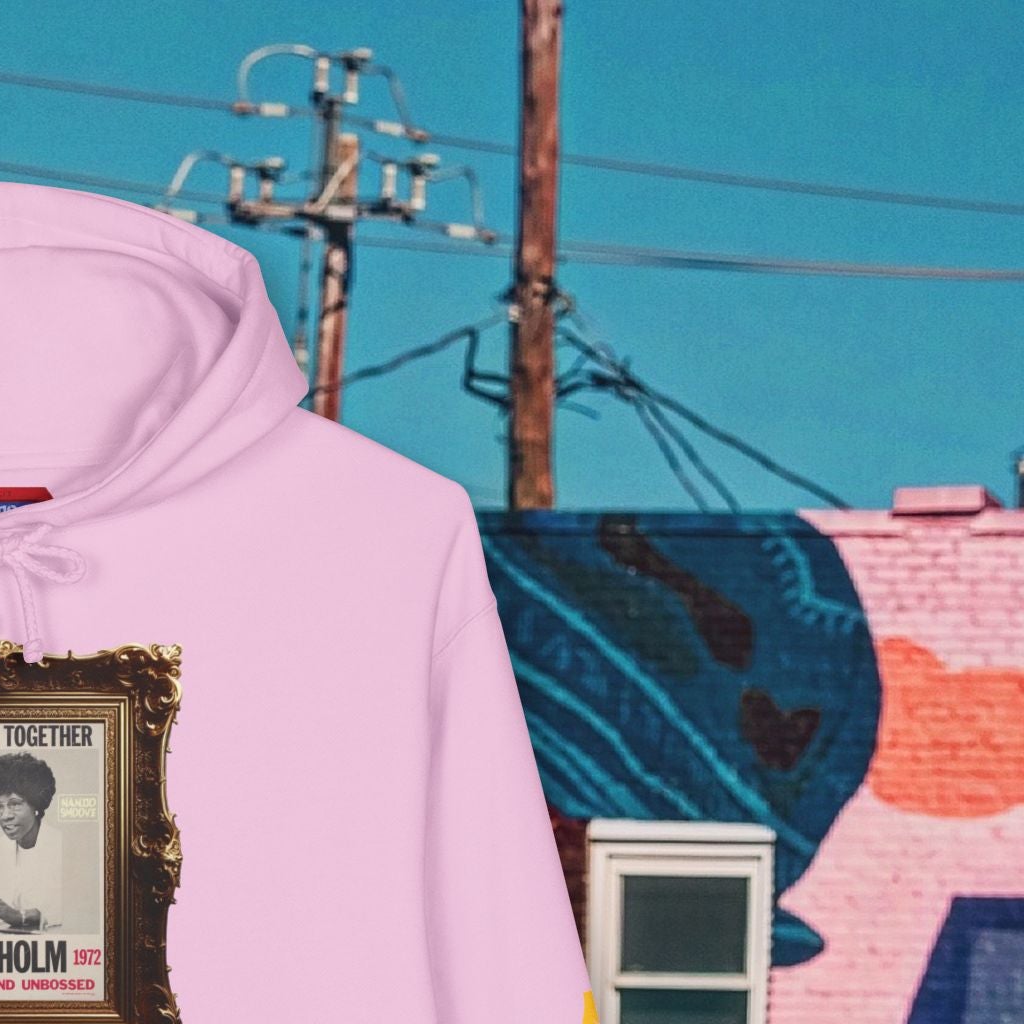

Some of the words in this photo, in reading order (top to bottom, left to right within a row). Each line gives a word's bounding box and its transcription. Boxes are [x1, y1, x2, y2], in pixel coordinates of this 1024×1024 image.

[4, 725, 93, 747] TOGETHER
[73, 948, 102, 966] 1972
[22, 979, 95, 991] UNBOSSED
